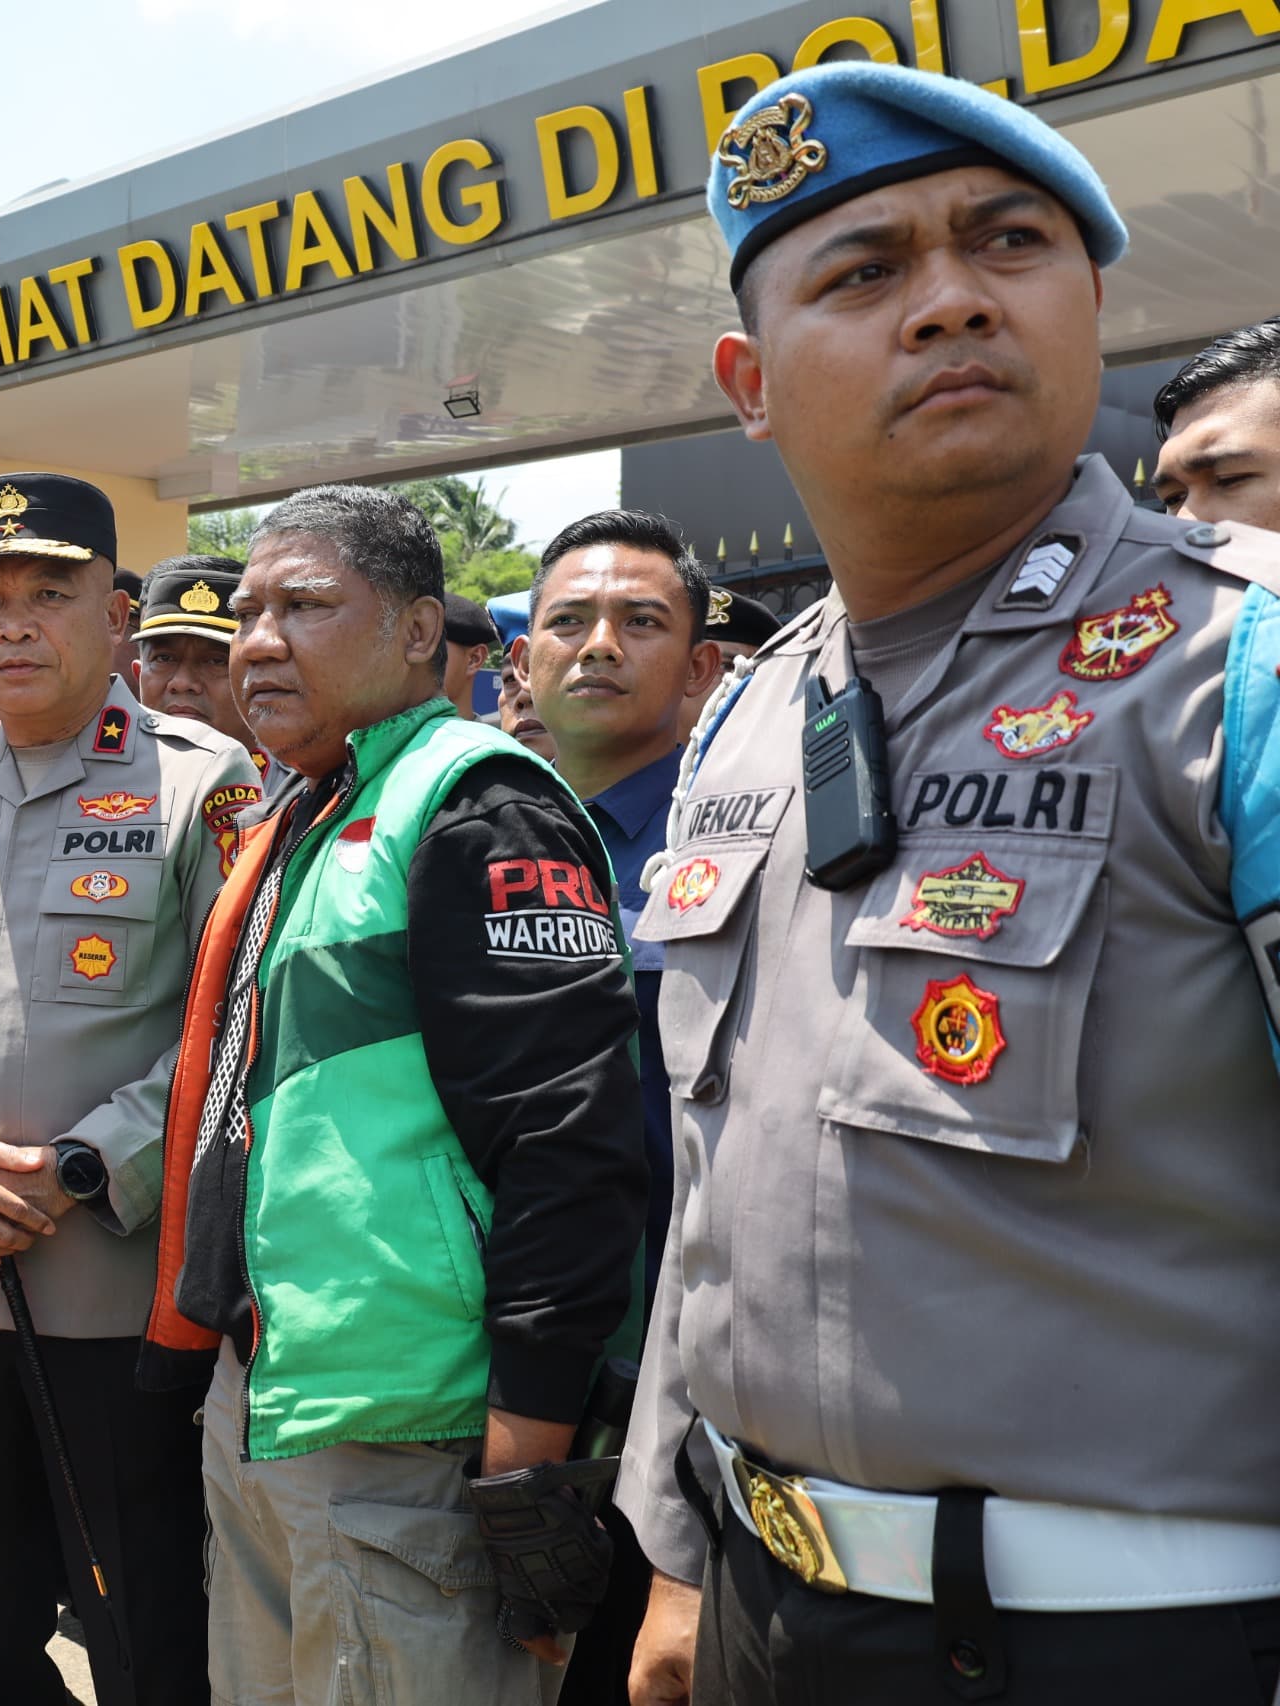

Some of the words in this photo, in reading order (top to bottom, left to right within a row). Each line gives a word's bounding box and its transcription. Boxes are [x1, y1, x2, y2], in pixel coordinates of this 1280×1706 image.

[118, 138, 506, 330] DATANG
[535, 85, 660, 220] DI
[205, 788, 258, 815] POLDA
[907, 769, 1091, 831] POLRI
[63, 829, 155, 856] POLRI
[485, 917, 618, 954] WARRIORS
